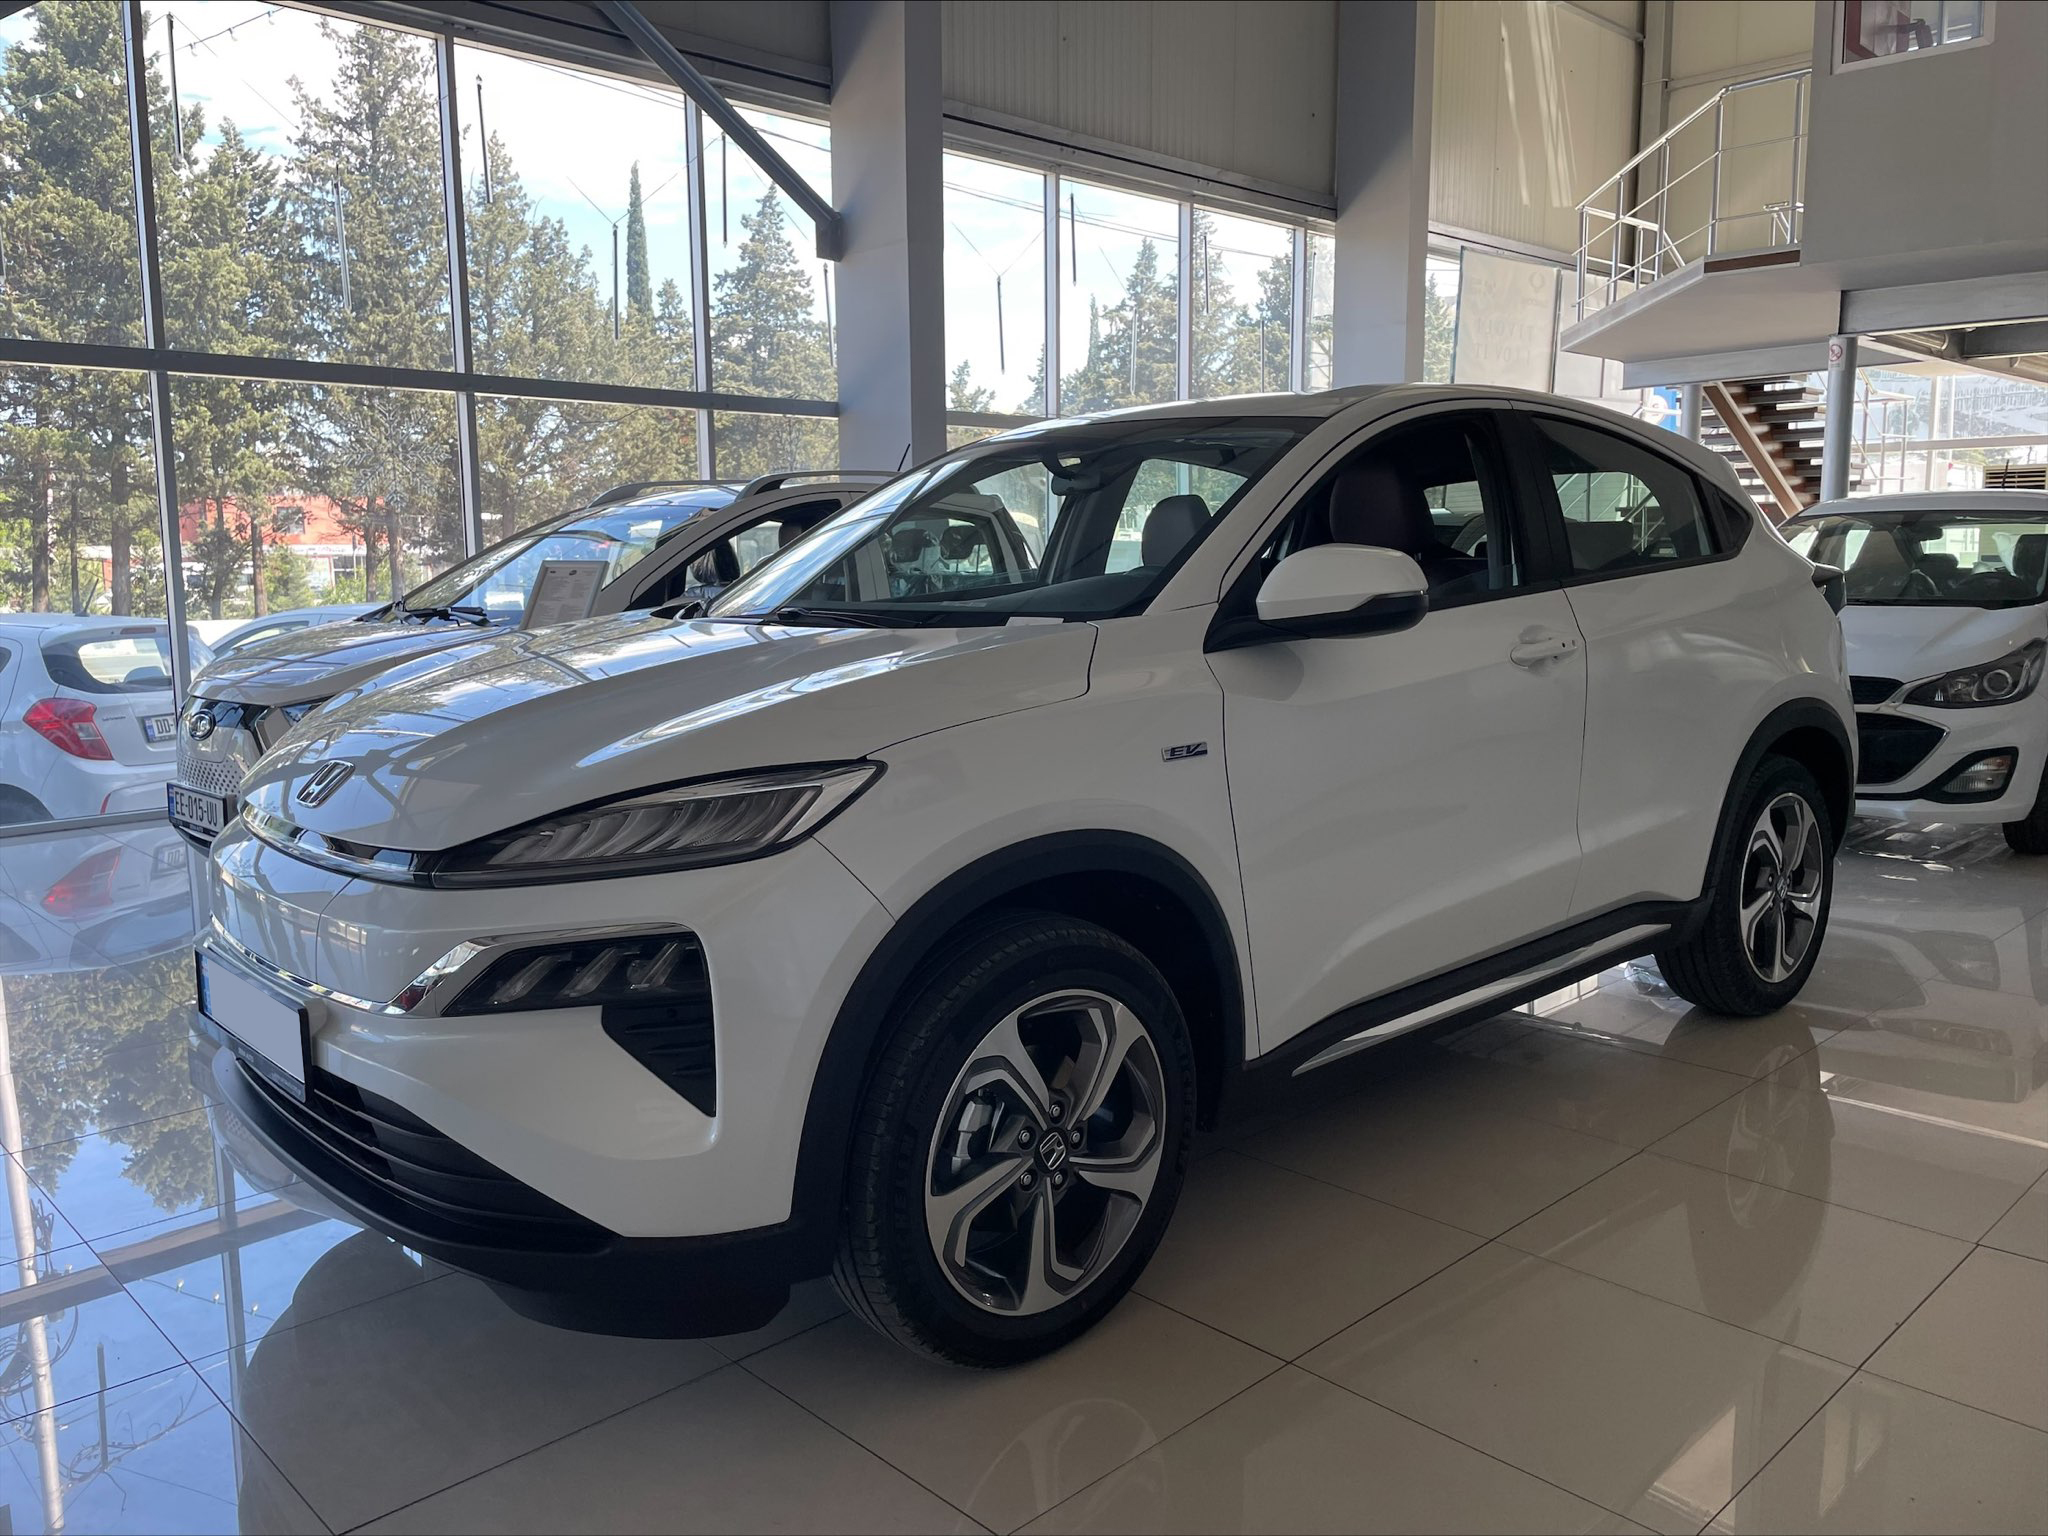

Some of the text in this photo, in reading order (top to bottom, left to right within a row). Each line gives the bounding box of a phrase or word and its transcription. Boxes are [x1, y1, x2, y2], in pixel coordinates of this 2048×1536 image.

[155, 718, 175, 734] DD-
[1170, 743, 1202, 757] EV
[174, 791, 218, 827] EE-015-UU
